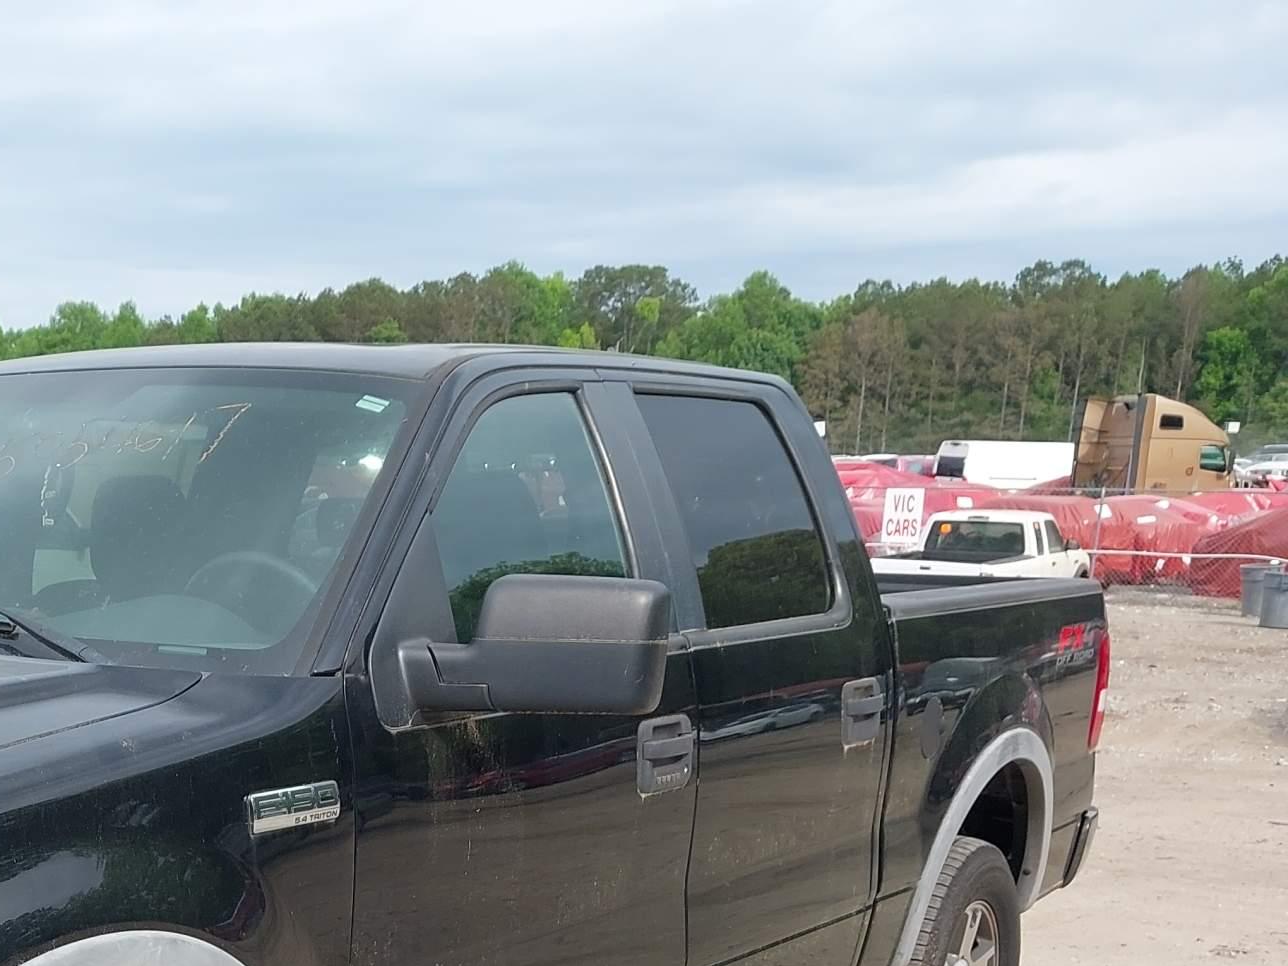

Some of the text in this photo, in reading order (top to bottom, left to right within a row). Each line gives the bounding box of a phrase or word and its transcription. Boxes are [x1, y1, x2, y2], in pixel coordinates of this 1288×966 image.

[893, 494, 916, 512] VIC
[885, 518, 918, 537] CARS
[309, 809, 338, 822] TRITON
